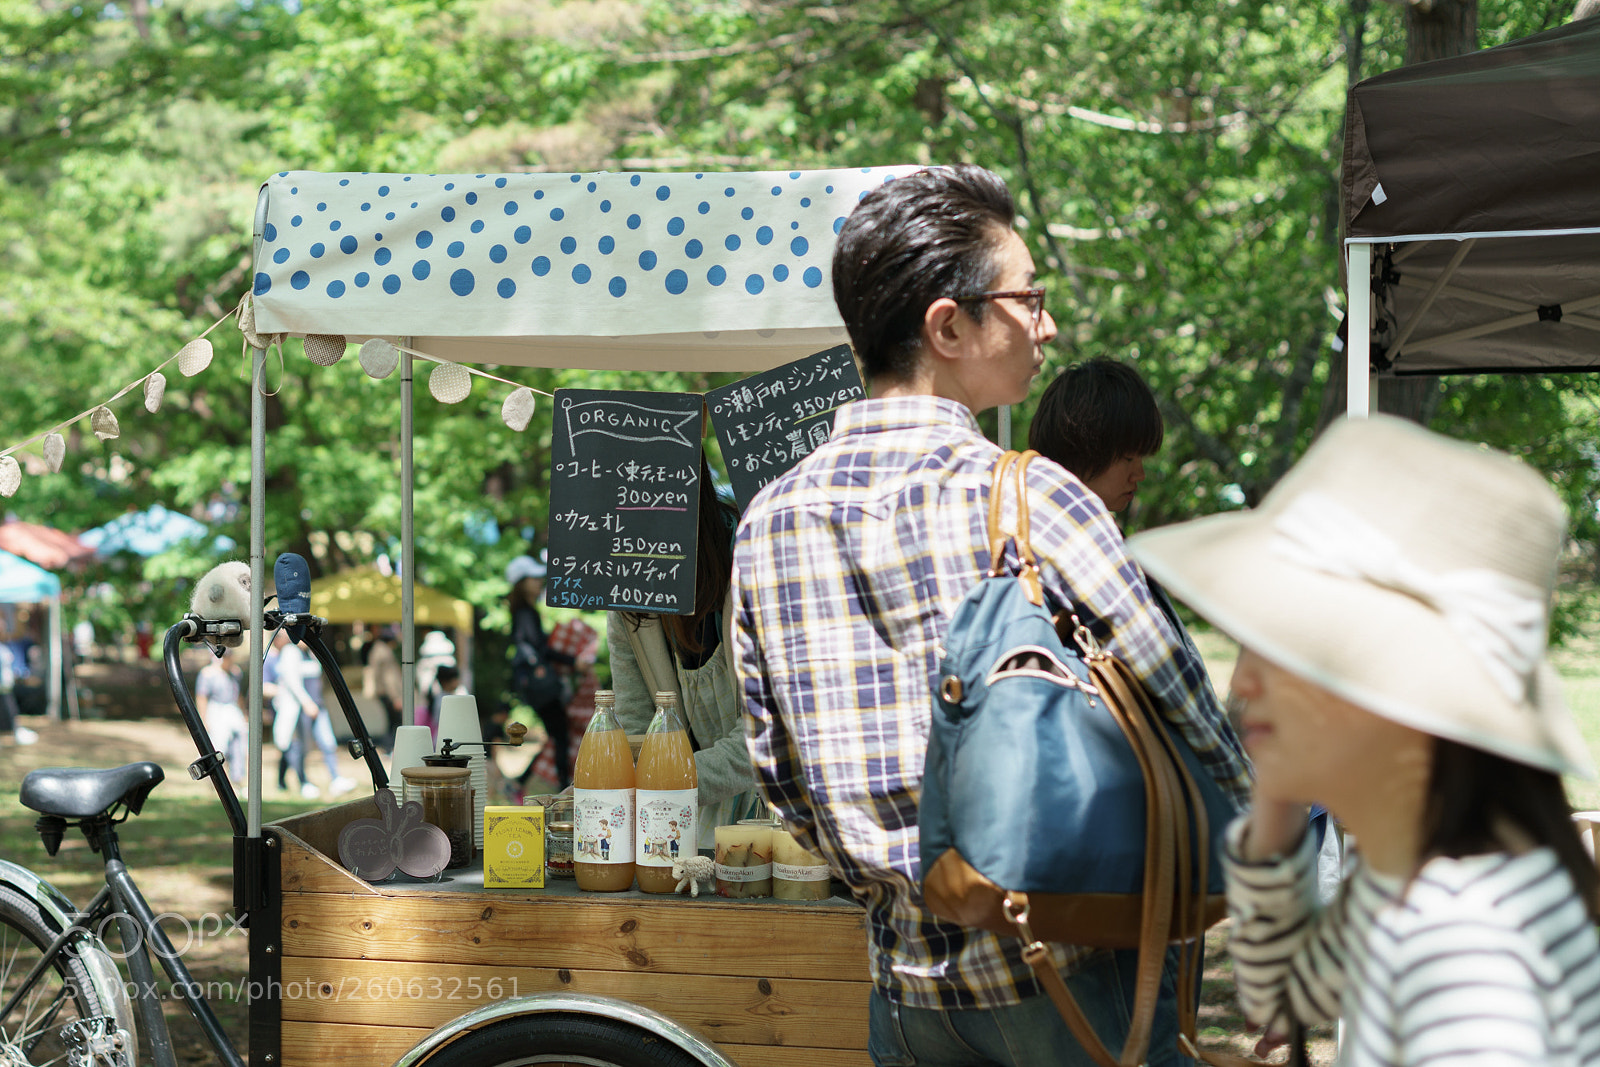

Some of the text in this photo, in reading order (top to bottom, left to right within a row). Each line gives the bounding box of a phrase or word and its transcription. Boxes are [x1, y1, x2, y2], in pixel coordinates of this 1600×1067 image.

[579, 409, 671, 433] ORGANIC
[726, 385, 862, 446] レモンティー 350yen
[617, 486, 688, 507] 300yen
[564, 509, 625, 533] カフェオレ
[612, 538, 682, 555] 350yen
[563, 556, 680, 581] ライスミルクチャイ
[550, 577, 583, 590] アイス
[609, 585, 678, 605] 400yen
